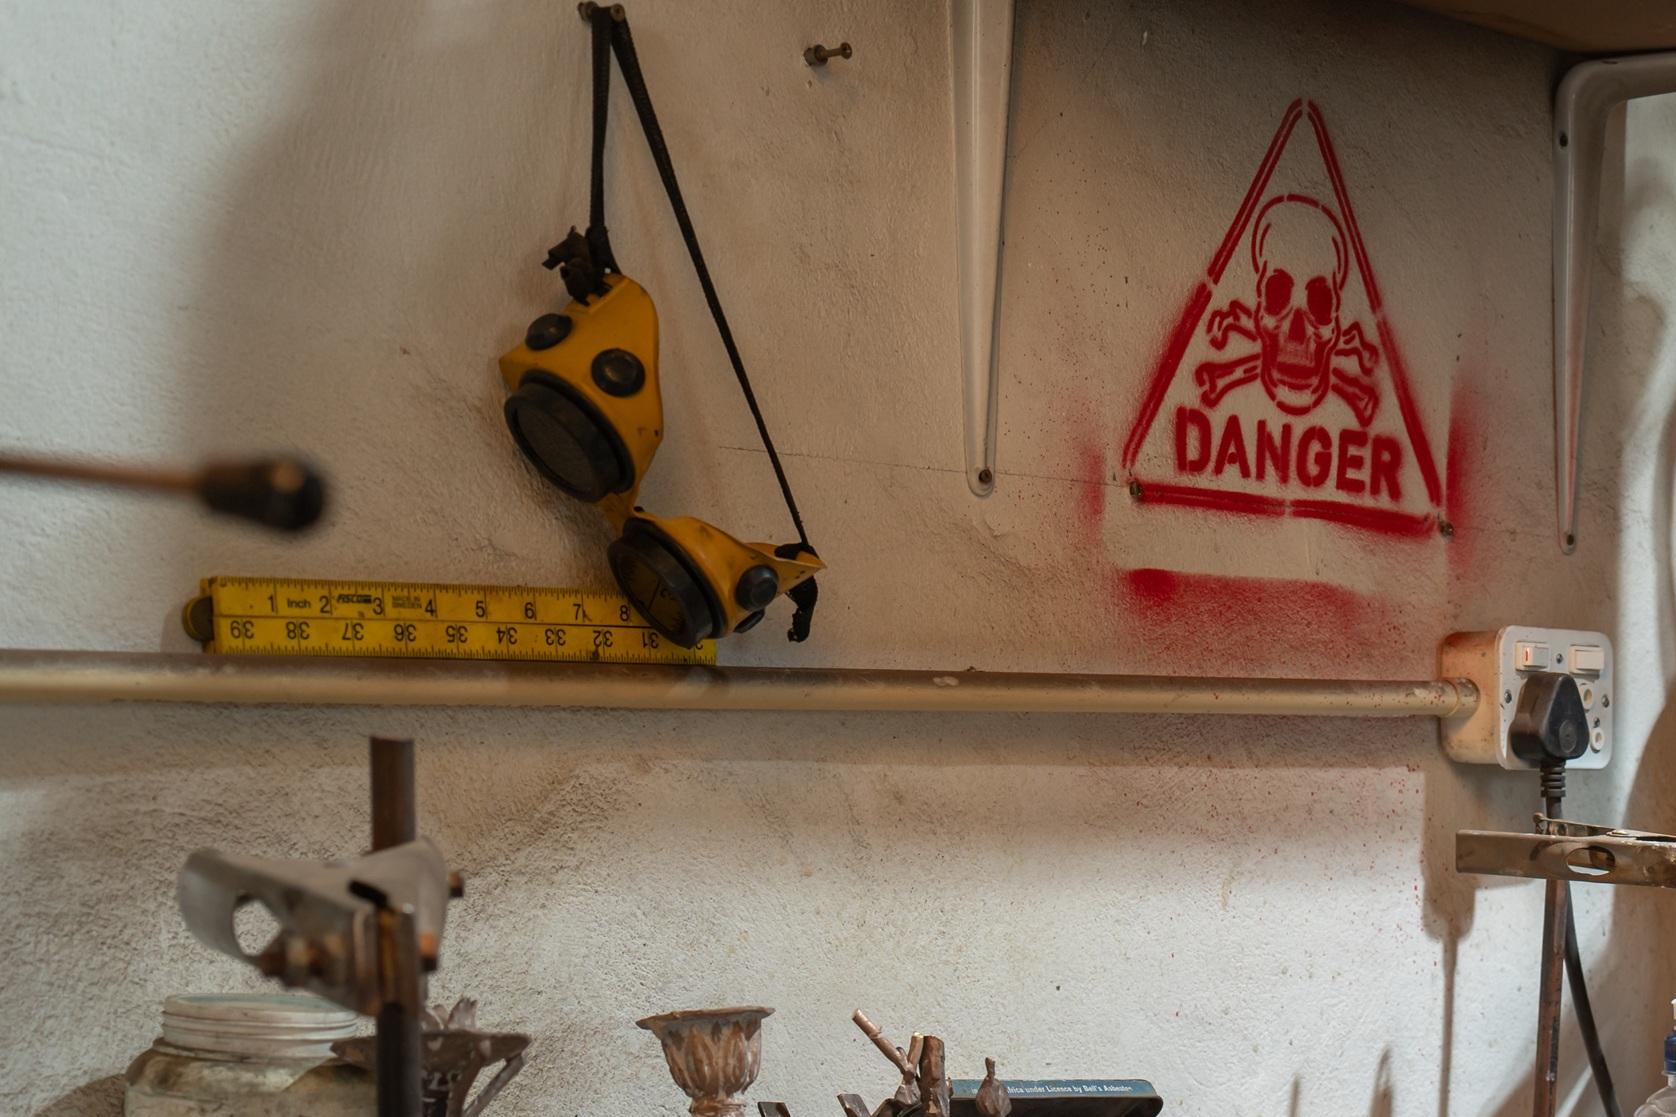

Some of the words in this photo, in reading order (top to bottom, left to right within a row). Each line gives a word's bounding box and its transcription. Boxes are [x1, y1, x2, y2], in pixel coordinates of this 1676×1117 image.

[1175, 405, 1403, 501] DANGER
[267, 595, 275, 613] 1
[319, 595, 330, 614] 2
[372, 597, 383, 615] 3
[424, 598, 436, 616] 4
[475, 601, 485, 618] 5
[524, 602, 535, 619] 6
[573, 603, 582, 620] 7
[619, 605, 630, 621] 8
[229, 620, 254, 640] 39
[286, 620, 310, 640] 38
[342, 622, 364, 641] 37
[393, 623, 416, 642] 36
[445, 624, 468, 644] 35
[496, 626, 517, 645] 34
[544, 627, 566, 647] 33
[592, 629, 613, 648] 32
[641, 631, 659, 649] 31
